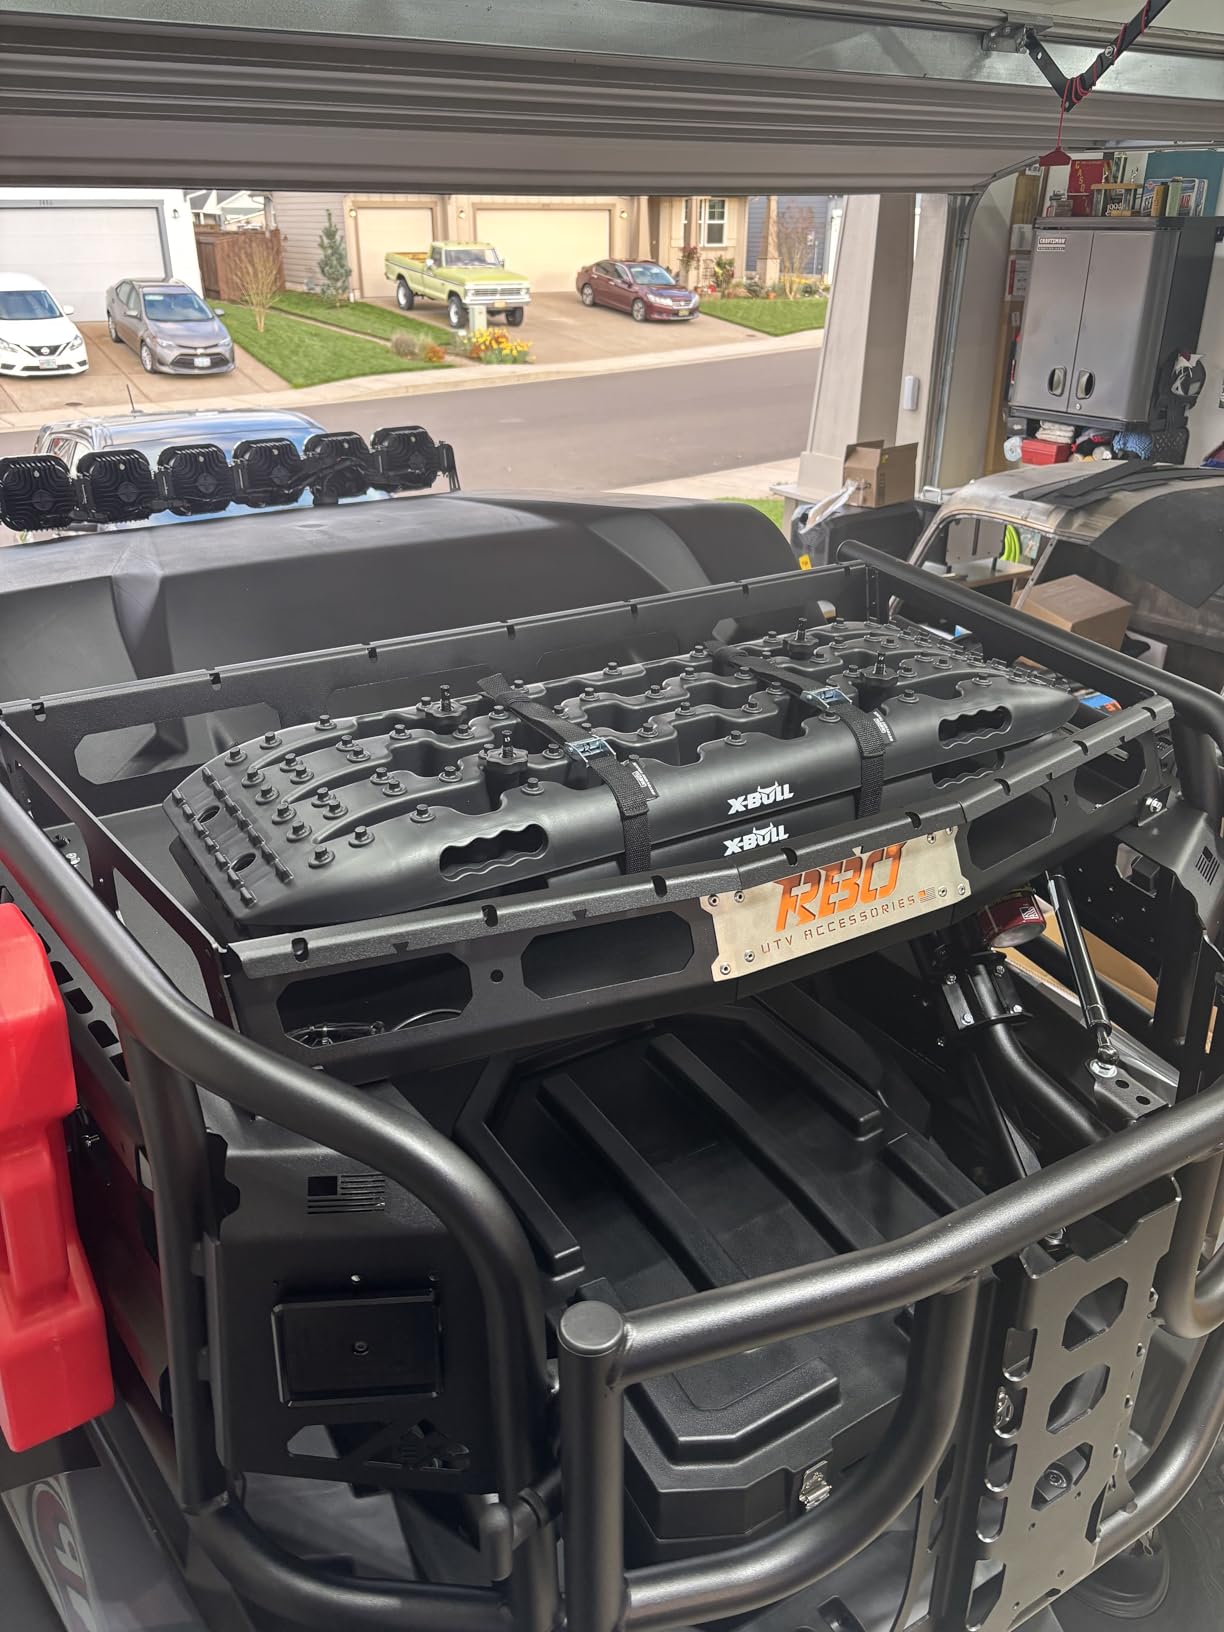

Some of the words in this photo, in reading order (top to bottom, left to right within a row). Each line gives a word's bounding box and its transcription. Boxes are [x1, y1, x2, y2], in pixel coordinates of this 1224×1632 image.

[727, 781, 794, 815] X-BULL
[723, 822, 790, 857] X-BULL
[761, 935, 793, 953] UTV
[804, 895, 916, 941] ACCESSORIES
